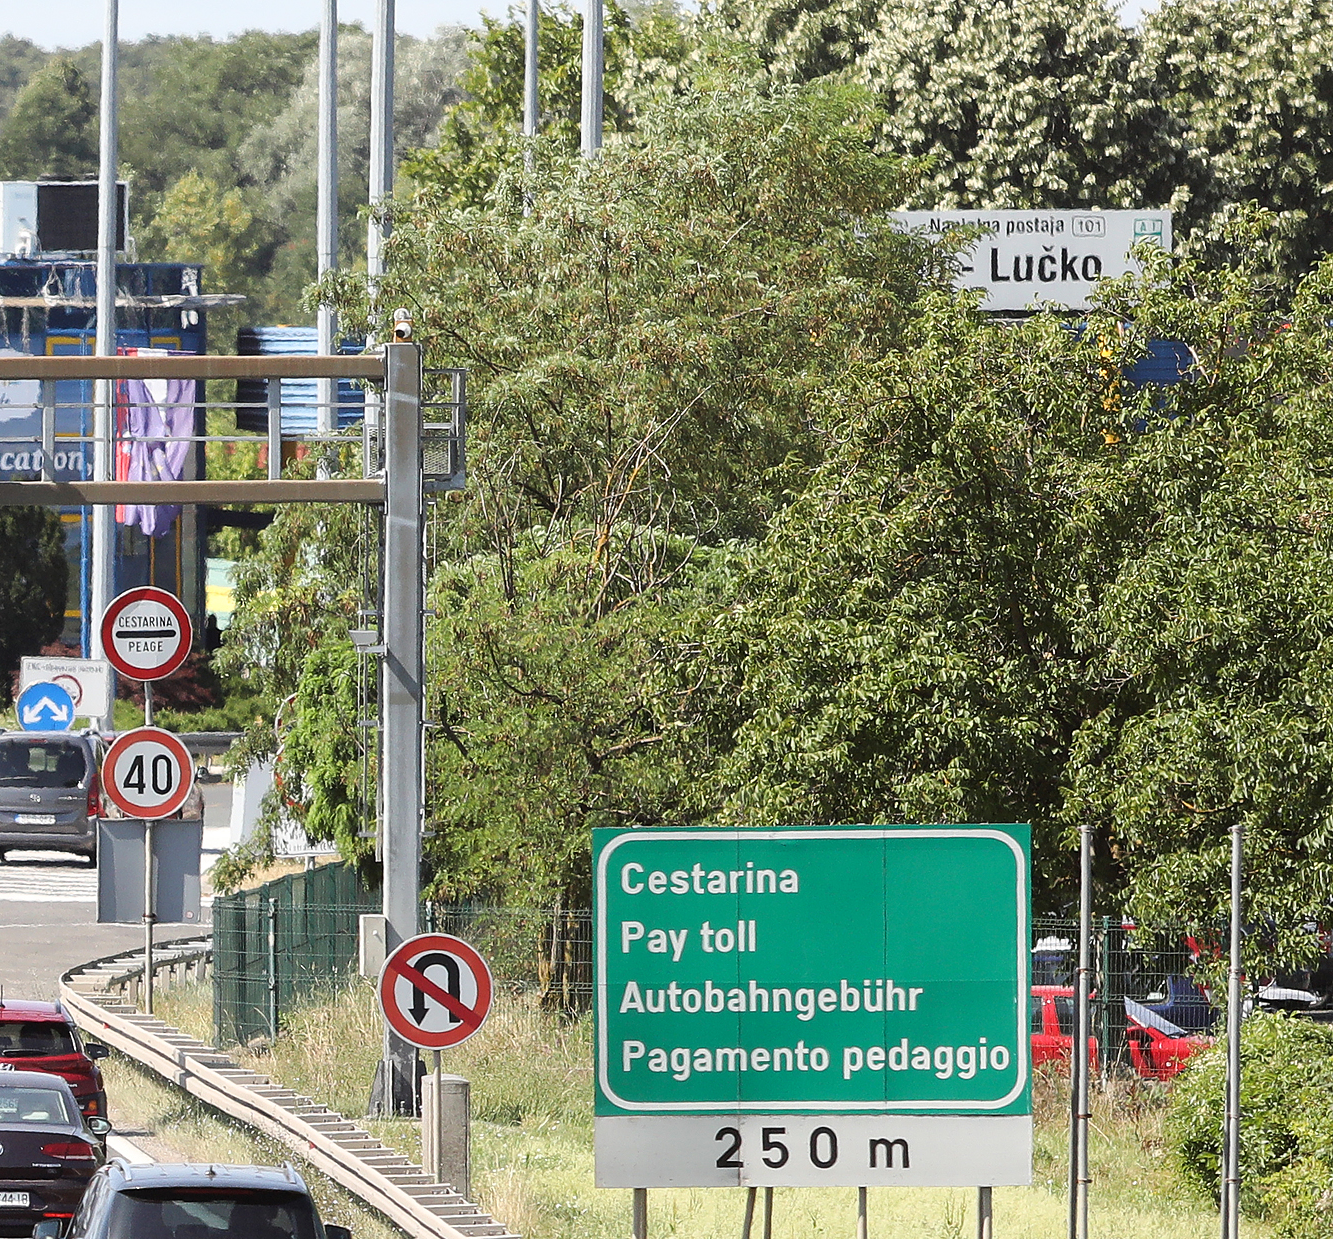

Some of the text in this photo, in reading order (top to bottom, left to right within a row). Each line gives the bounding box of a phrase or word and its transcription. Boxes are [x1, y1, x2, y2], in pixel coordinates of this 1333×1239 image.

[1006, 216, 1065, 236] postaja
[1077, 221, 1101, 233] 101
[990, 246, 1102, 283] Lučko
[118, 616, 174, 629] CESTARINA
[128, 641, 164, 653] PEAGE
[122, 754, 174, 796] 40
[620, 862, 800, 895] Cestarina
[620, 919, 757, 963] Pay toll
[619, 979, 924, 1022] Autobahngebühr
[622, 1036, 1011, 1082] Pagamento pedaggio
[714, 1126, 911, 1170] 250 m
